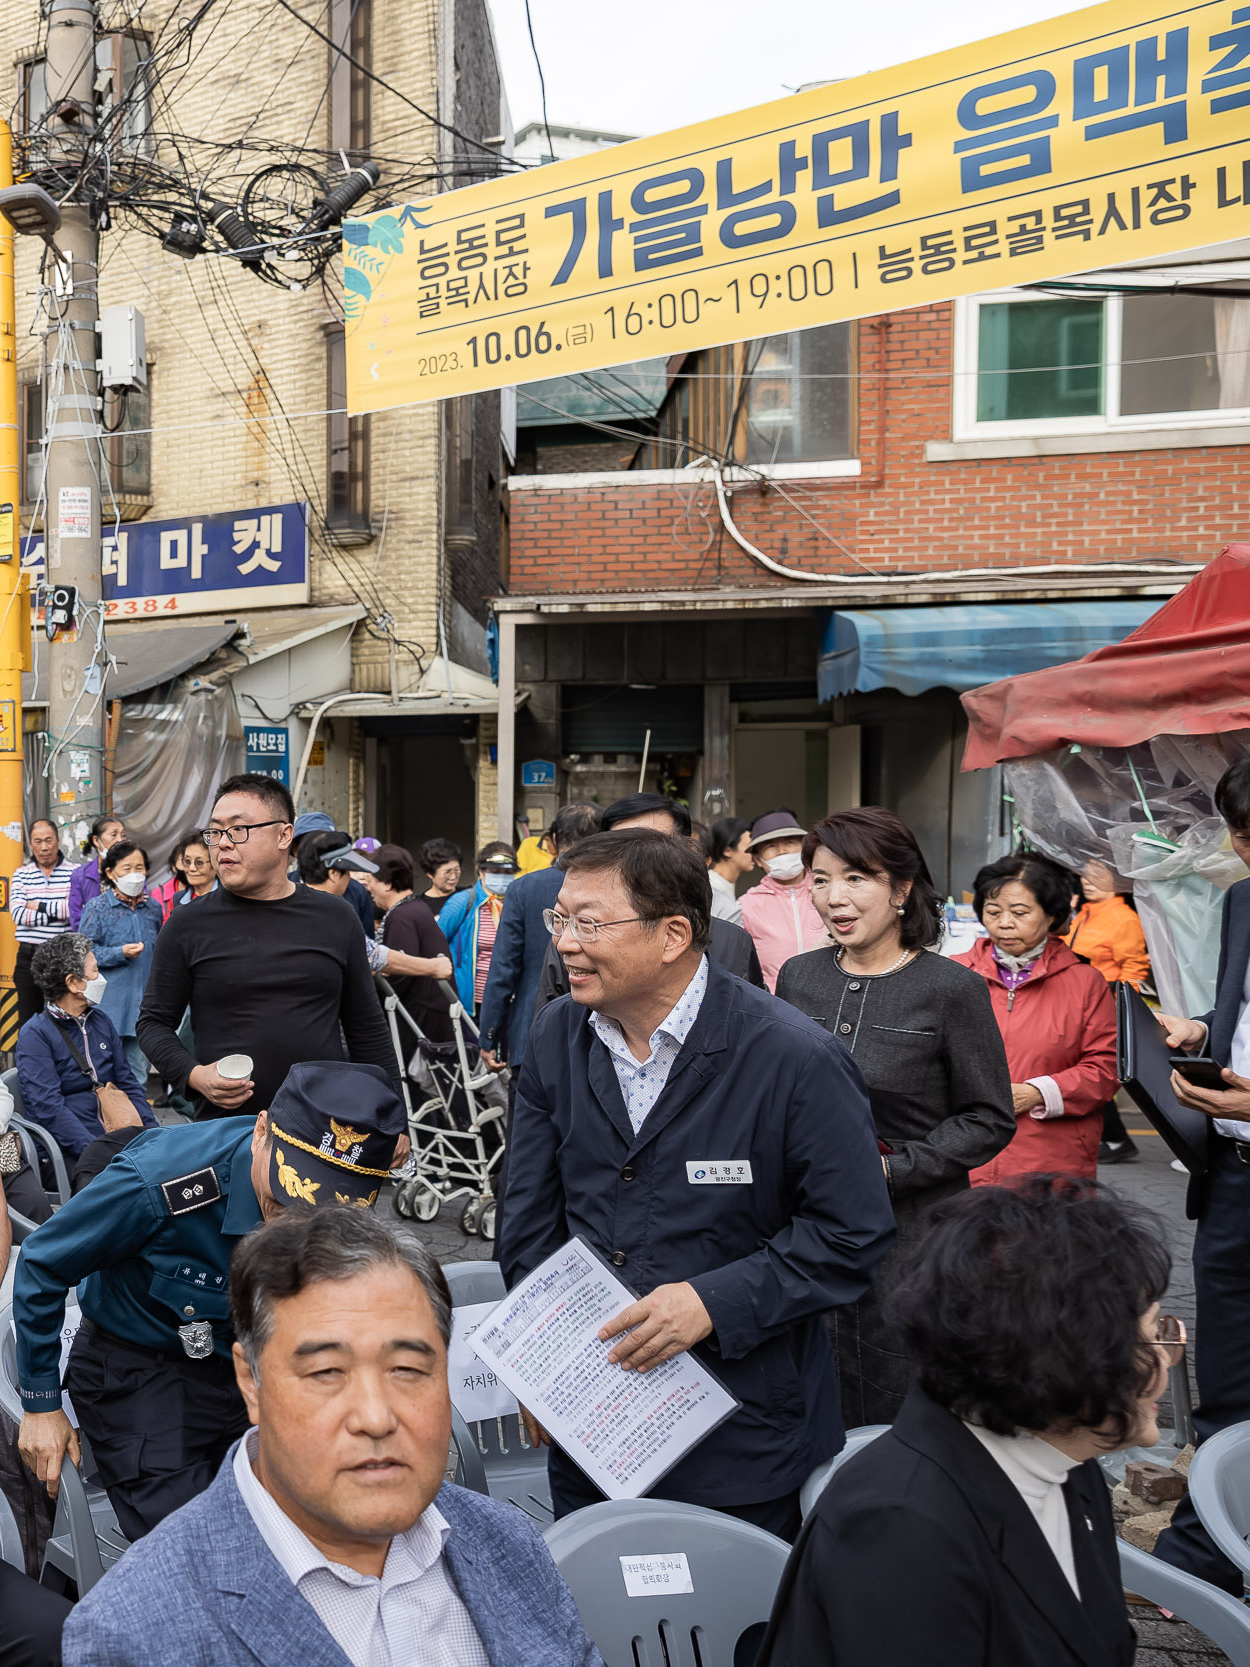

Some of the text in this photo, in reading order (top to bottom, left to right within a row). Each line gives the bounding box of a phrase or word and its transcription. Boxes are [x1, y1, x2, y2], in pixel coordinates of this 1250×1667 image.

[544, 110, 913, 287] 가을낭만
[416, 212, 530, 281] 능동로
[417, 350, 464, 377] 2023.
[603, 257, 834, 341] 16:00~19:00
[876, 173, 1197, 284] 능동로골목시장
[416, 260, 532, 320] 골목시장
[247, 732, 287, 753] 사원모집
